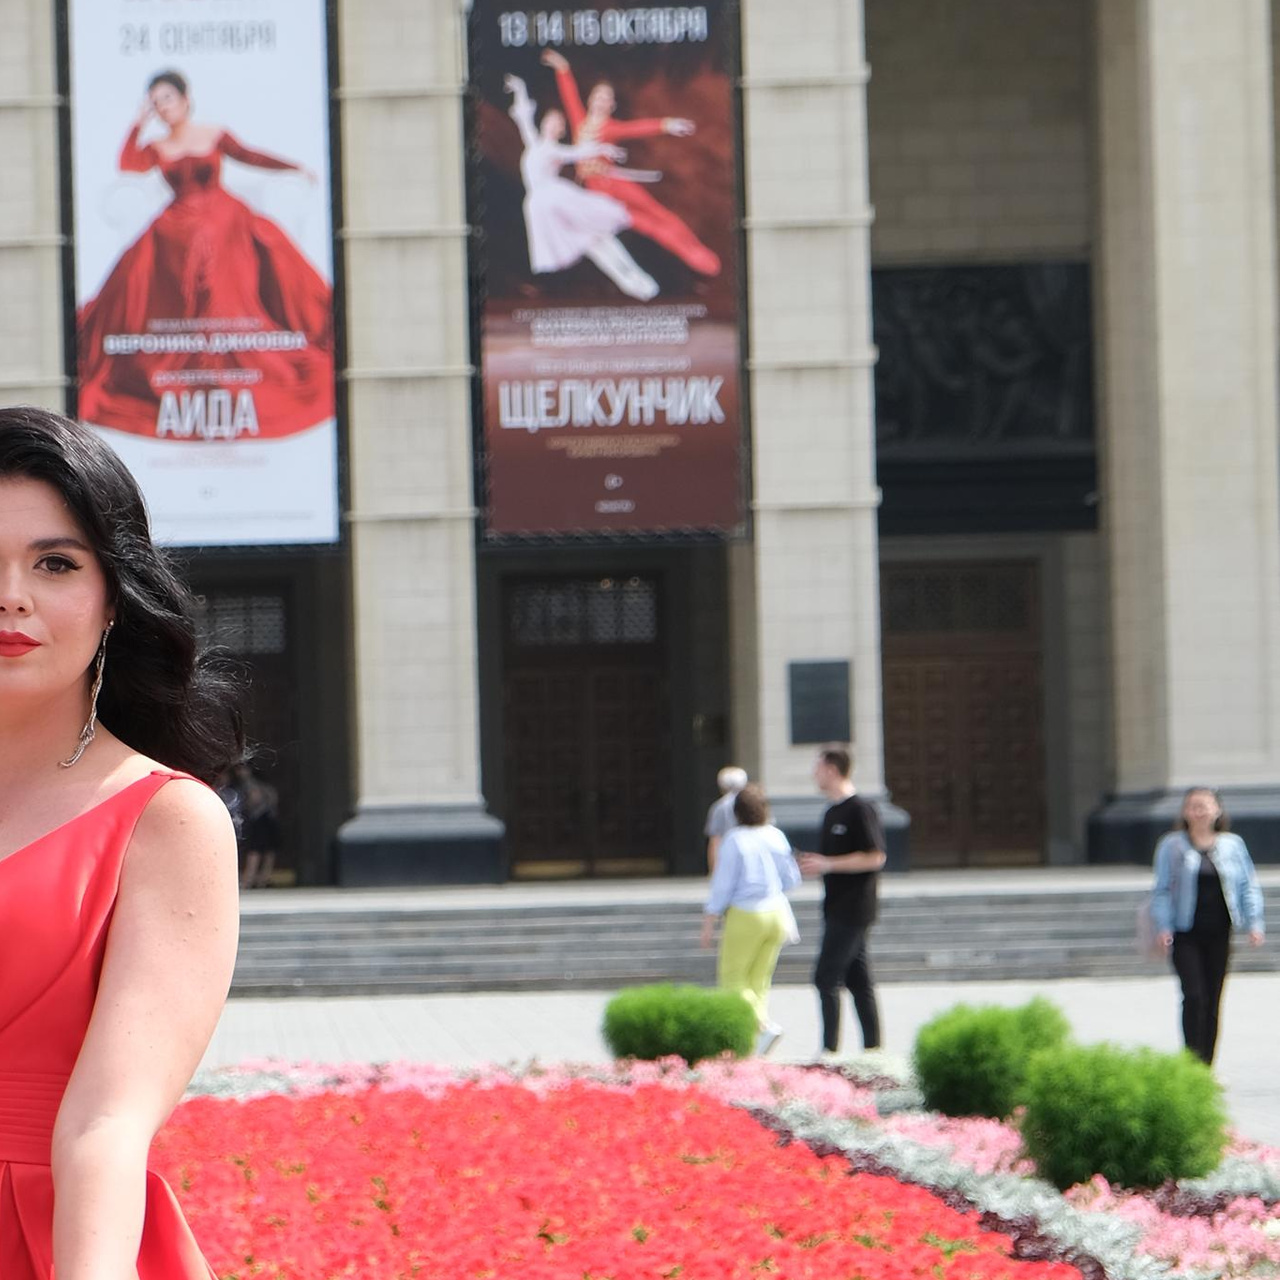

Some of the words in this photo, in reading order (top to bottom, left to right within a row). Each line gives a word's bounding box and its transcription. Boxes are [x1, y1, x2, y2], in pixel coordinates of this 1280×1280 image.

[120, 23, 151, 56] 24
[158, 22, 276, 54] СЕНТЯБРЯ
[536, 10, 564, 46] 14
[601, 6, 707, 44] ОКТЯБРЯ
[156, 389, 259, 441] АИДА
[499, 375, 725, 433] ЩЕЛКУНЧИК
